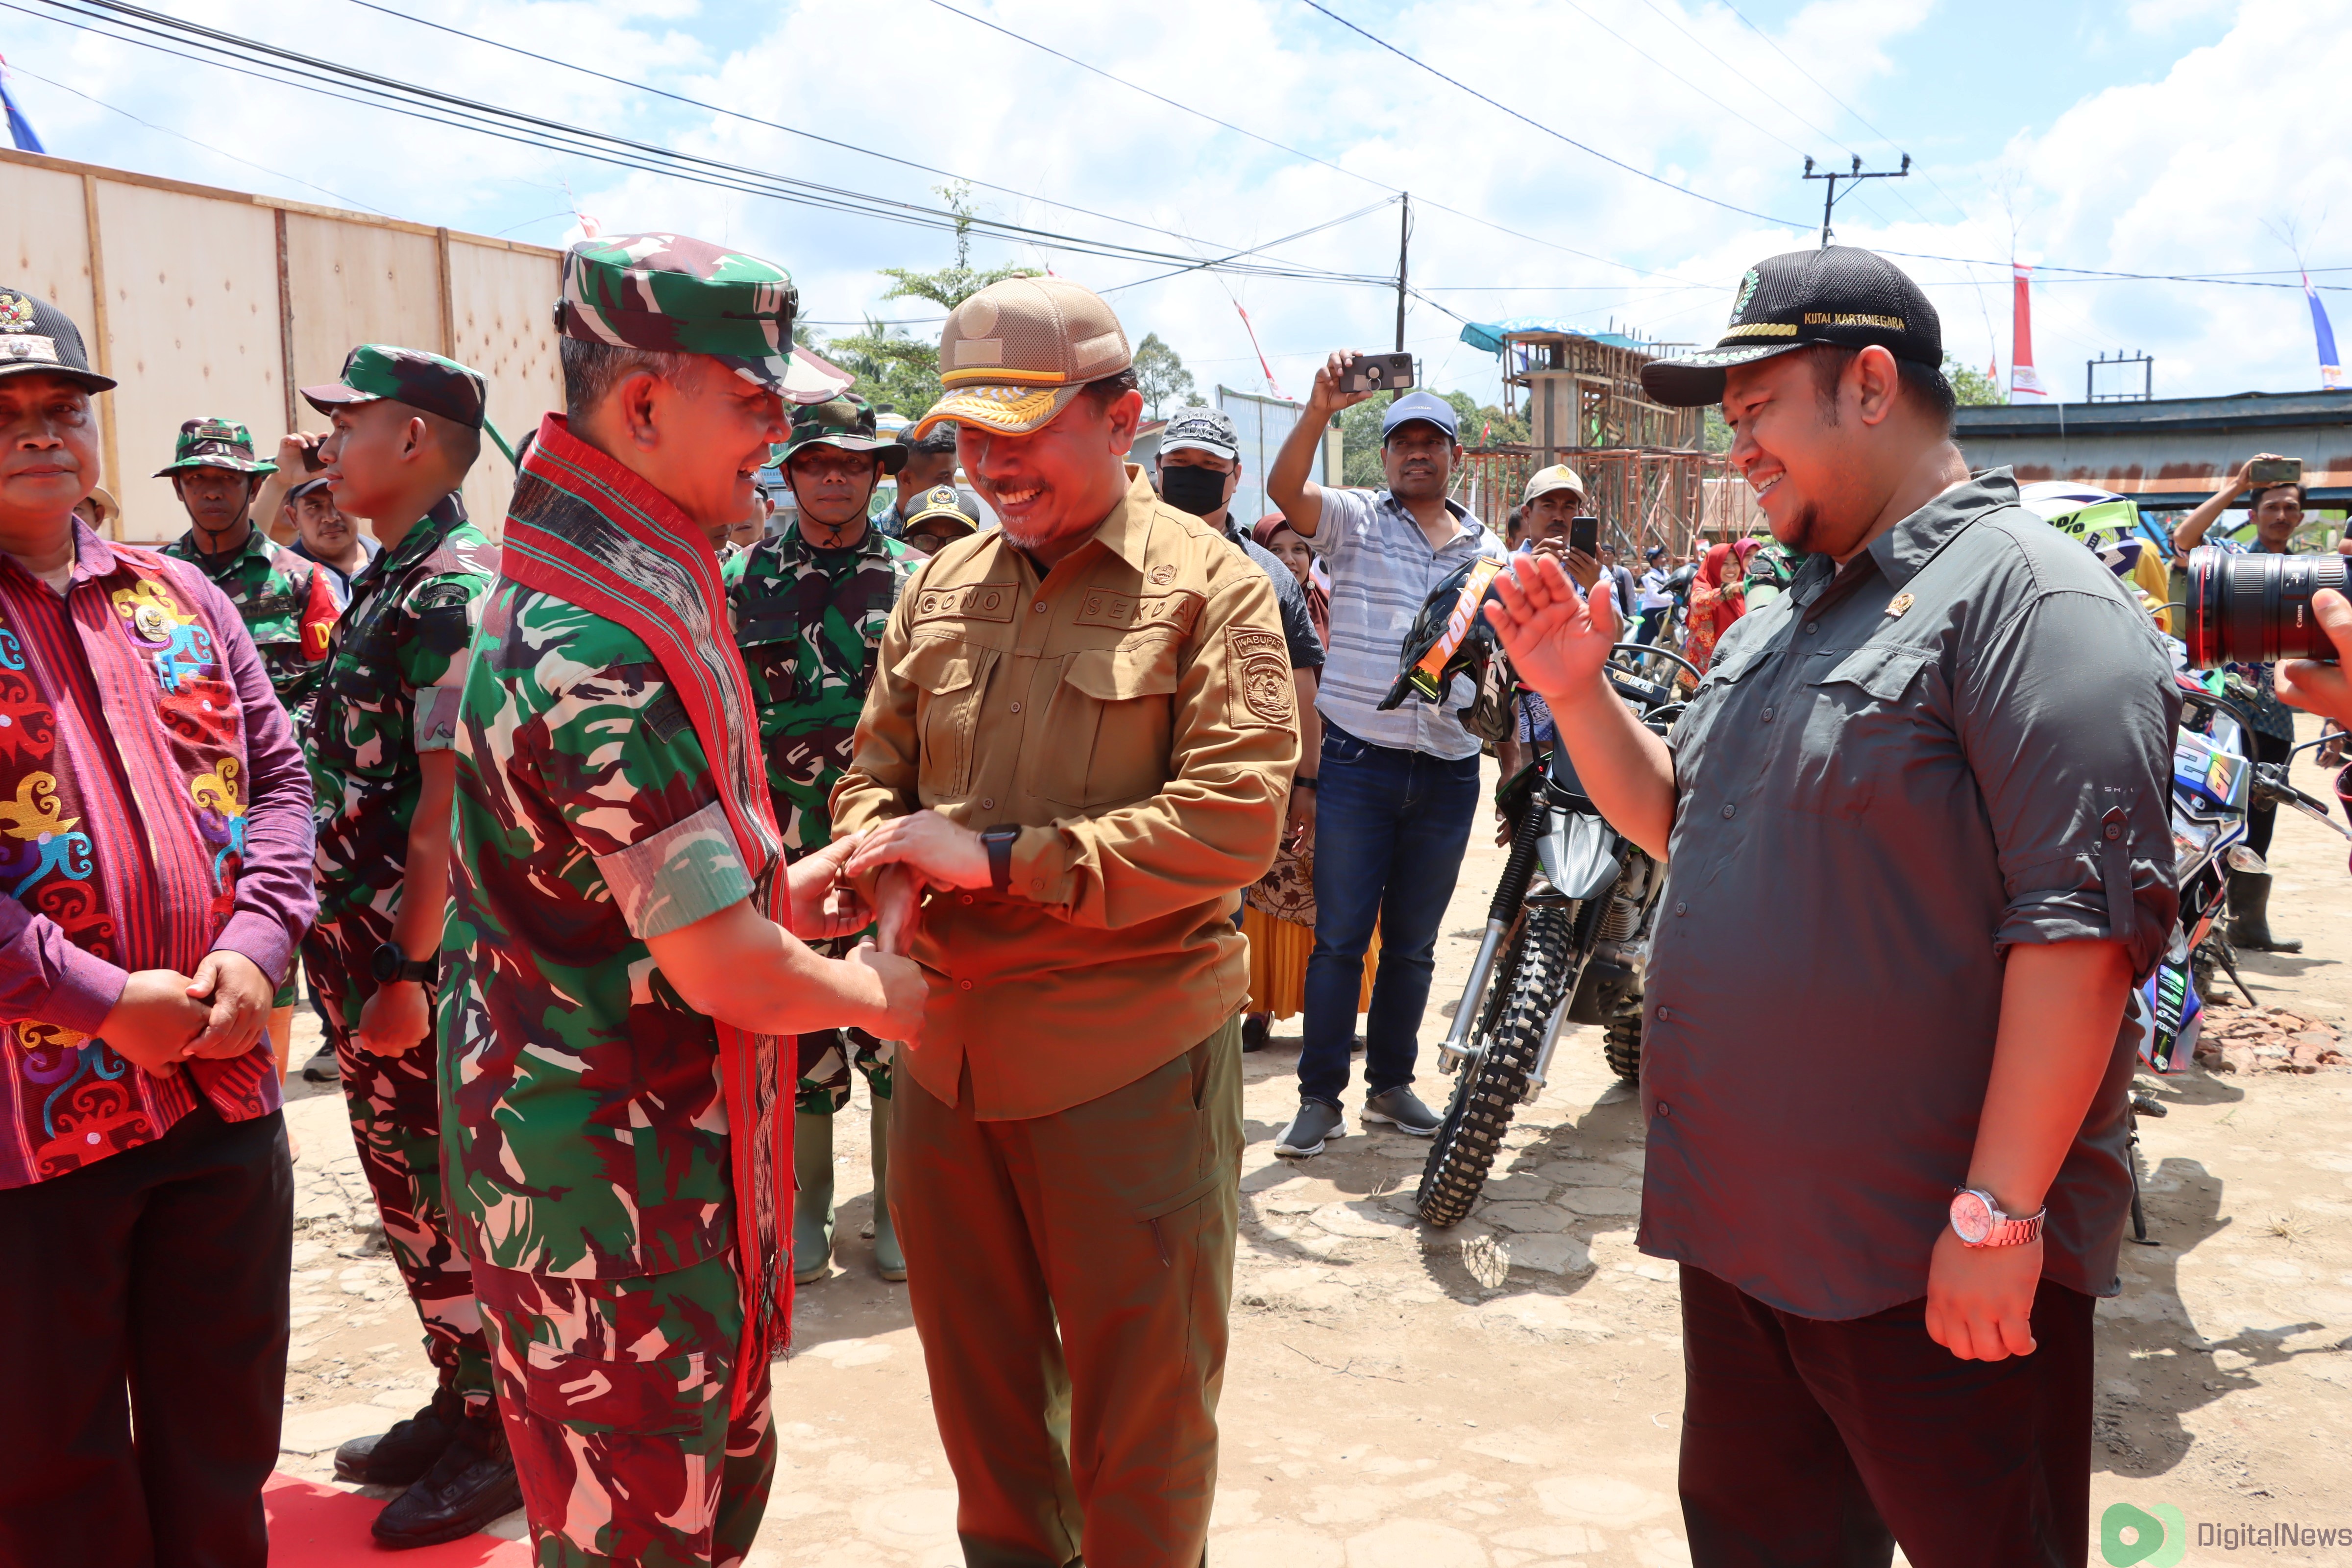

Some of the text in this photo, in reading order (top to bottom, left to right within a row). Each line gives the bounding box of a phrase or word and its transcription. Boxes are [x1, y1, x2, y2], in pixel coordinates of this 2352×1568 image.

[1804, 313, 1905, 330] KUTAI KARTANEGARA
[1176, 412, 1225, 431] ORIGINAL
[1190, 420, 1210, 428] THE
[1176, 427, 1223, 442] BLACK
[921, 591, 1001, 613] GONO
[1086, 597, 1189, 621] SEKDA
[1438, 570, 1490, 659] 100%
[1483, 641, 1508, 708] JPX
